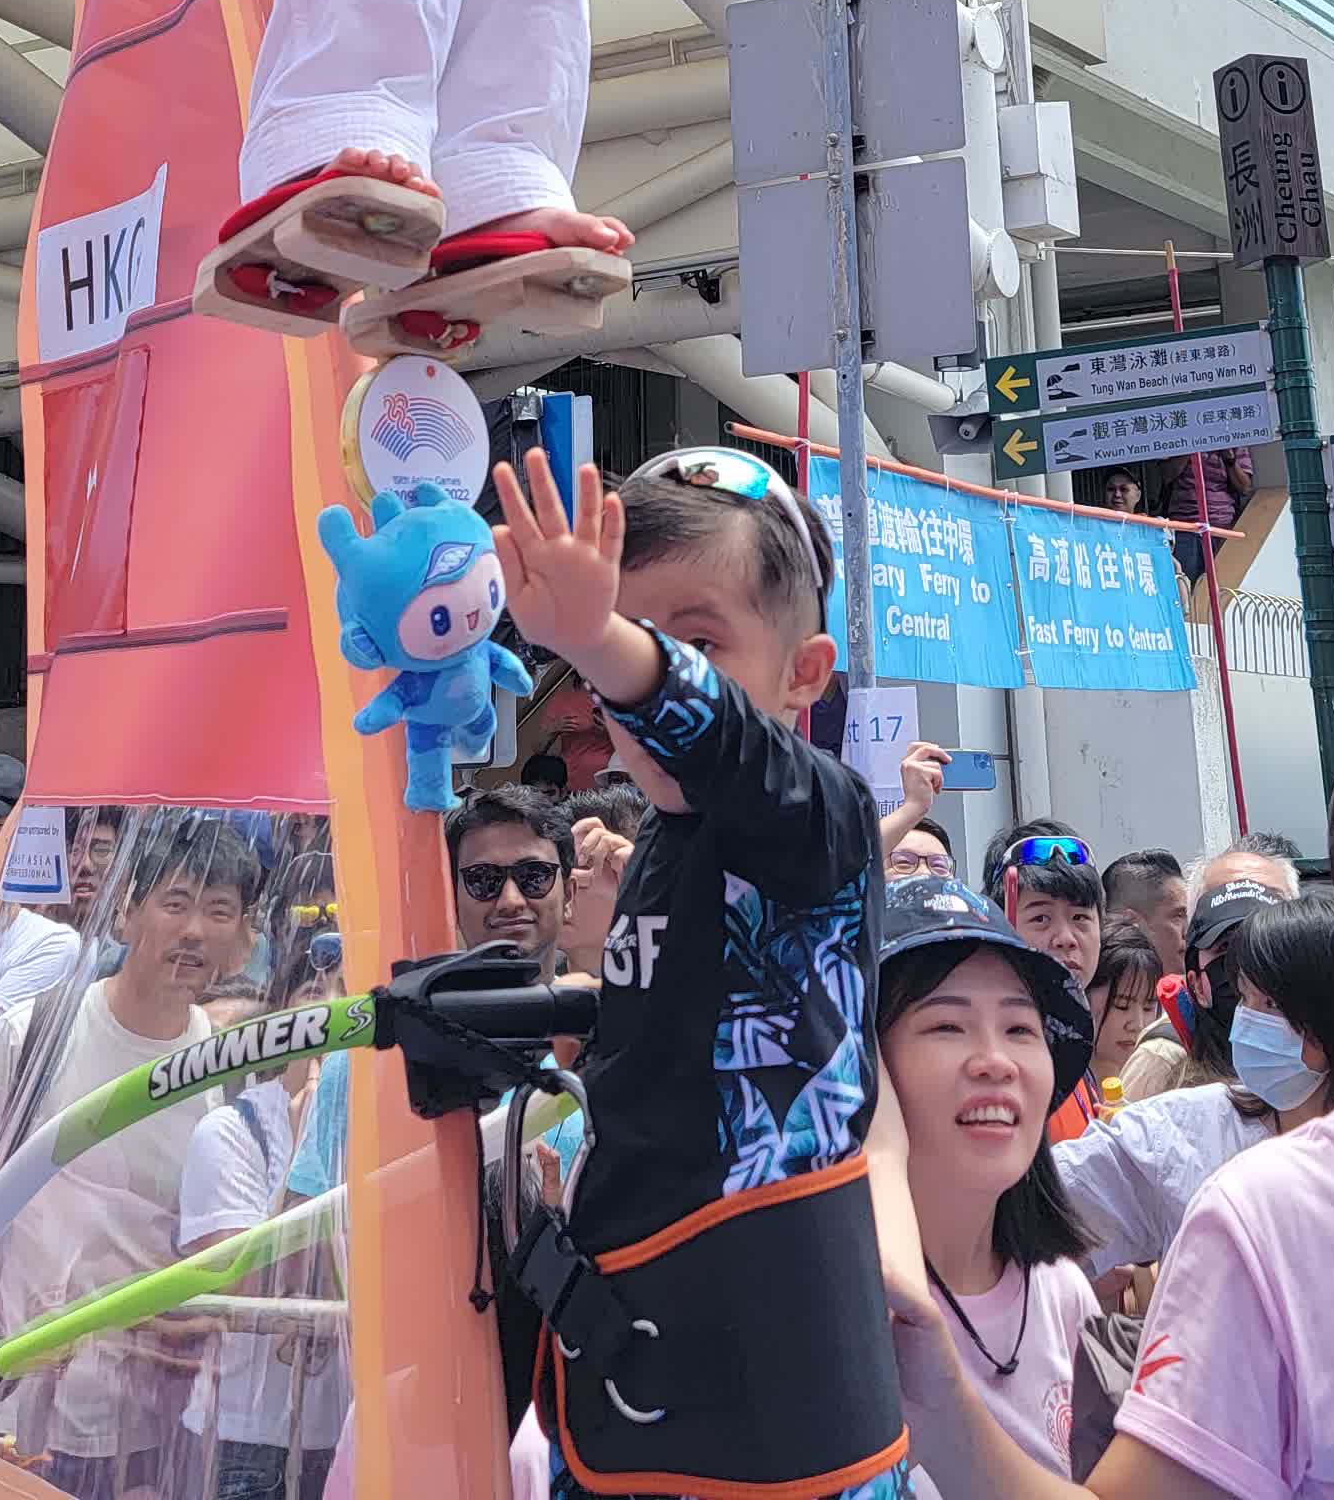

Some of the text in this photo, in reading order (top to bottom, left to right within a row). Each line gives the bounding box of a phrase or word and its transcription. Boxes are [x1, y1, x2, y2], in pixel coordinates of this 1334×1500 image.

[1228, 139, 1267, 253] 長洲
[1271, 132, 1298, 244] Cheung
[1299, 152, 1323, 228] Chau
[1091, 363, 1258, 397] Tung Wan Beach (via Tung Wan Rd)
[1094, 426, 1269, 461] Kwun Yam Beach (via Tung Wan Rd)
[921, 562, 961, 606] Ferry
[970, 578, 991, 604] to
[1027, 531, 1159, 598] 高速船往中環
[885, 604, 952, 643] Central
[1027, 614, 1174, 654] Fast Ferry to Central
[869, 715, 903, 742] 17
[148, 1004, 332, 1100] SIMMER
